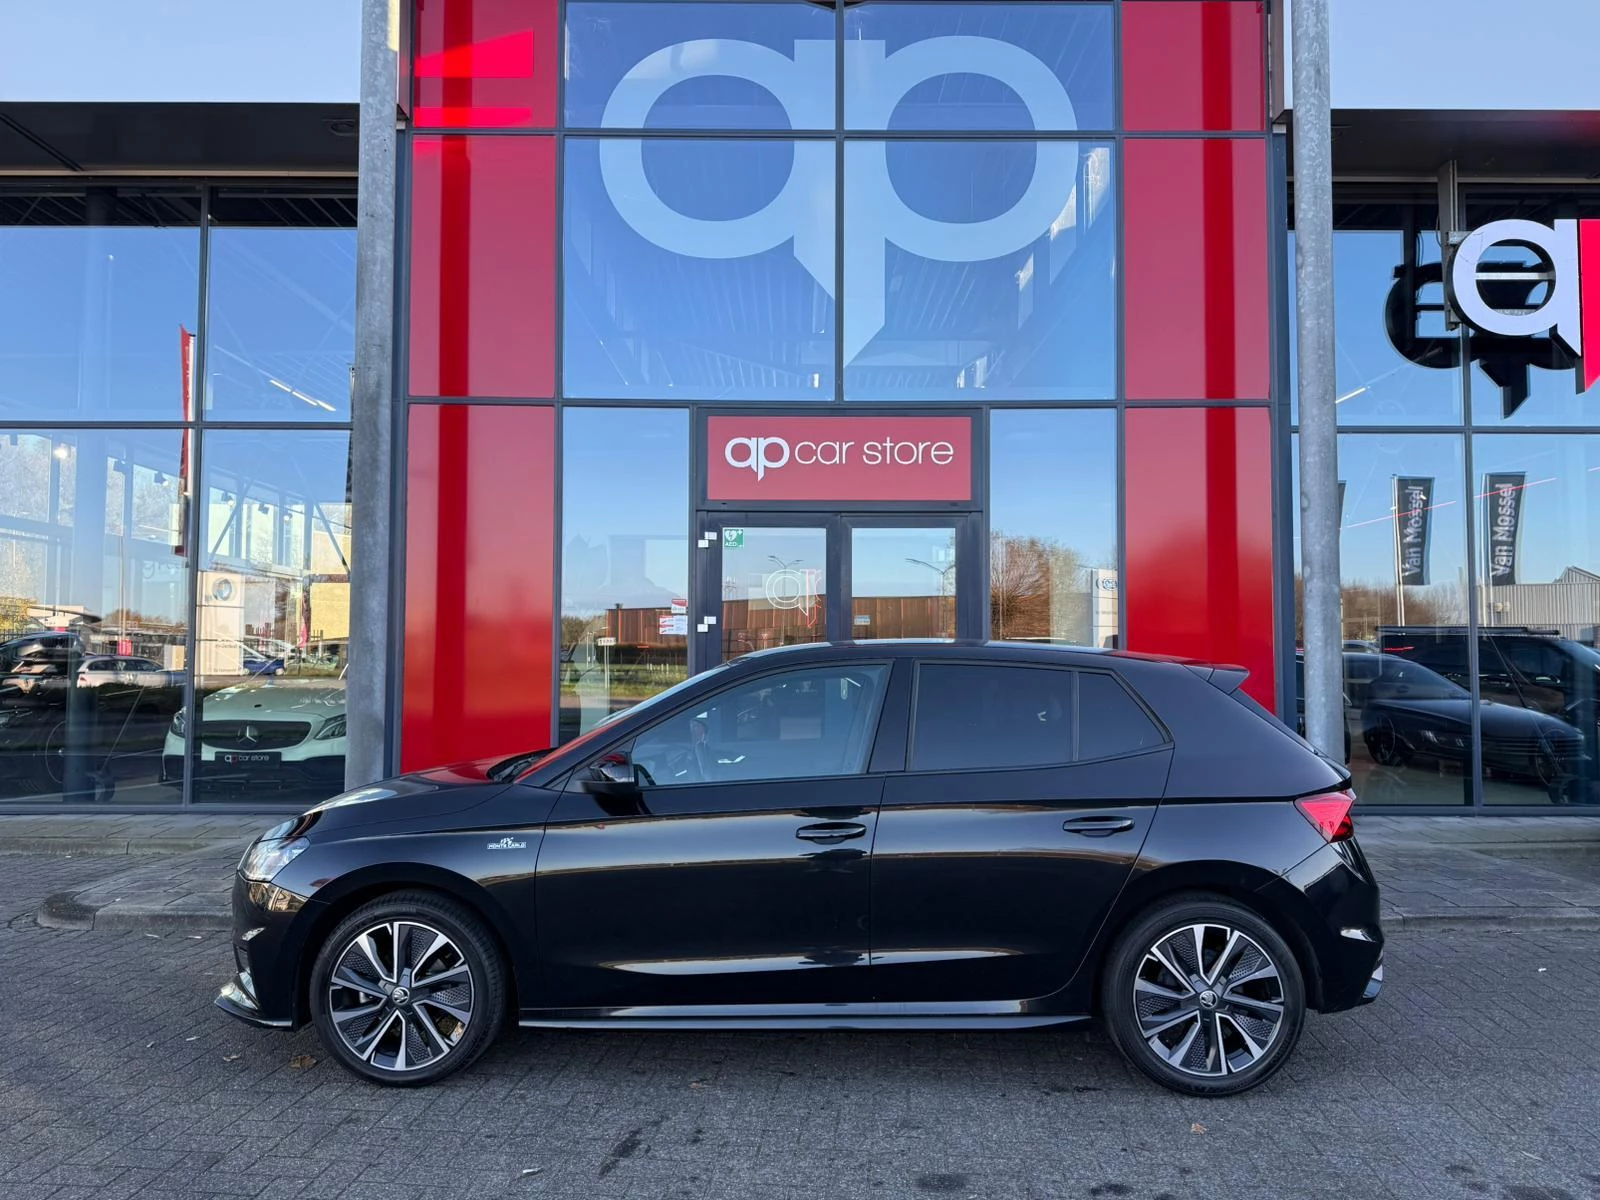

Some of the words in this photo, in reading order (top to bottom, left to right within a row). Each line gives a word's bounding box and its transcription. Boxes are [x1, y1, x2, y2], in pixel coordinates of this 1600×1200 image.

[600, 35, 1078, 368] ap
[724, 436, 790, 482] ap
[794, 441, 855, 465] car
[862, 436, 954, 465] store
[1492, 483, 1516, 542] Mossel
[1402, 547, 1422, 577] Van
[1491, 545, 1513, 577] Van
